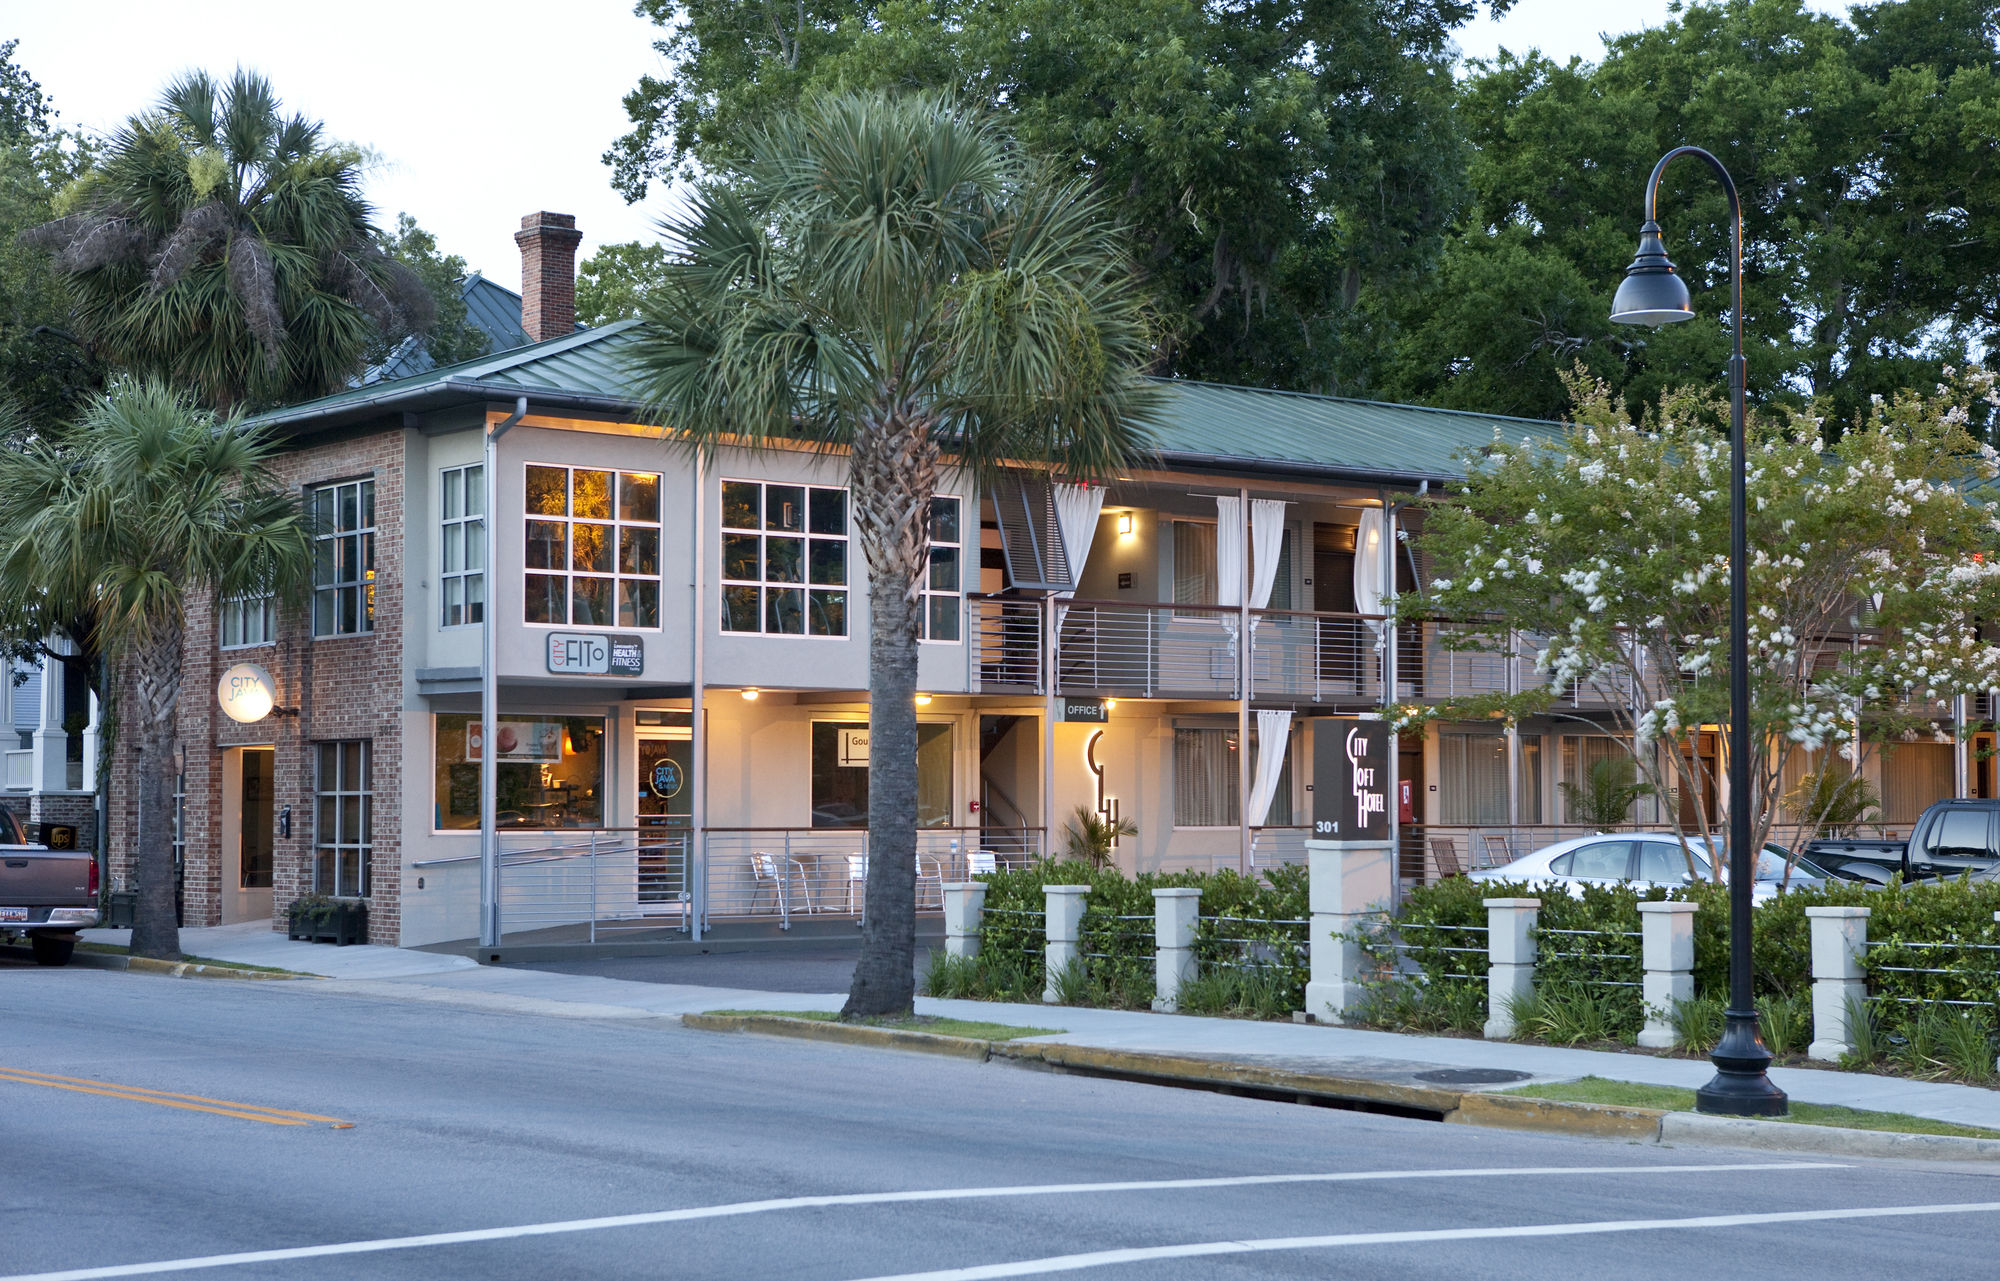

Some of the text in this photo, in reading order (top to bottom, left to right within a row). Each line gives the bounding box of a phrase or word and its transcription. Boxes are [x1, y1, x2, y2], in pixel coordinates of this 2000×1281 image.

[552, 639, 565, 667] CITY
[612, 649, 637, 658] HEALTH
[611, 657, 641, 668] FITNESS
[230, 676, 260, 687] CITY
[228, 687, 261, 702] JA
[1067, 705, 1098, 715] OFFICE
[655, 767, 674, 775] CITY
[655, 774, 676, 785] JAVA
[1315, 820, 1340, 833] 301
[53, 833, 71, 847] ups
